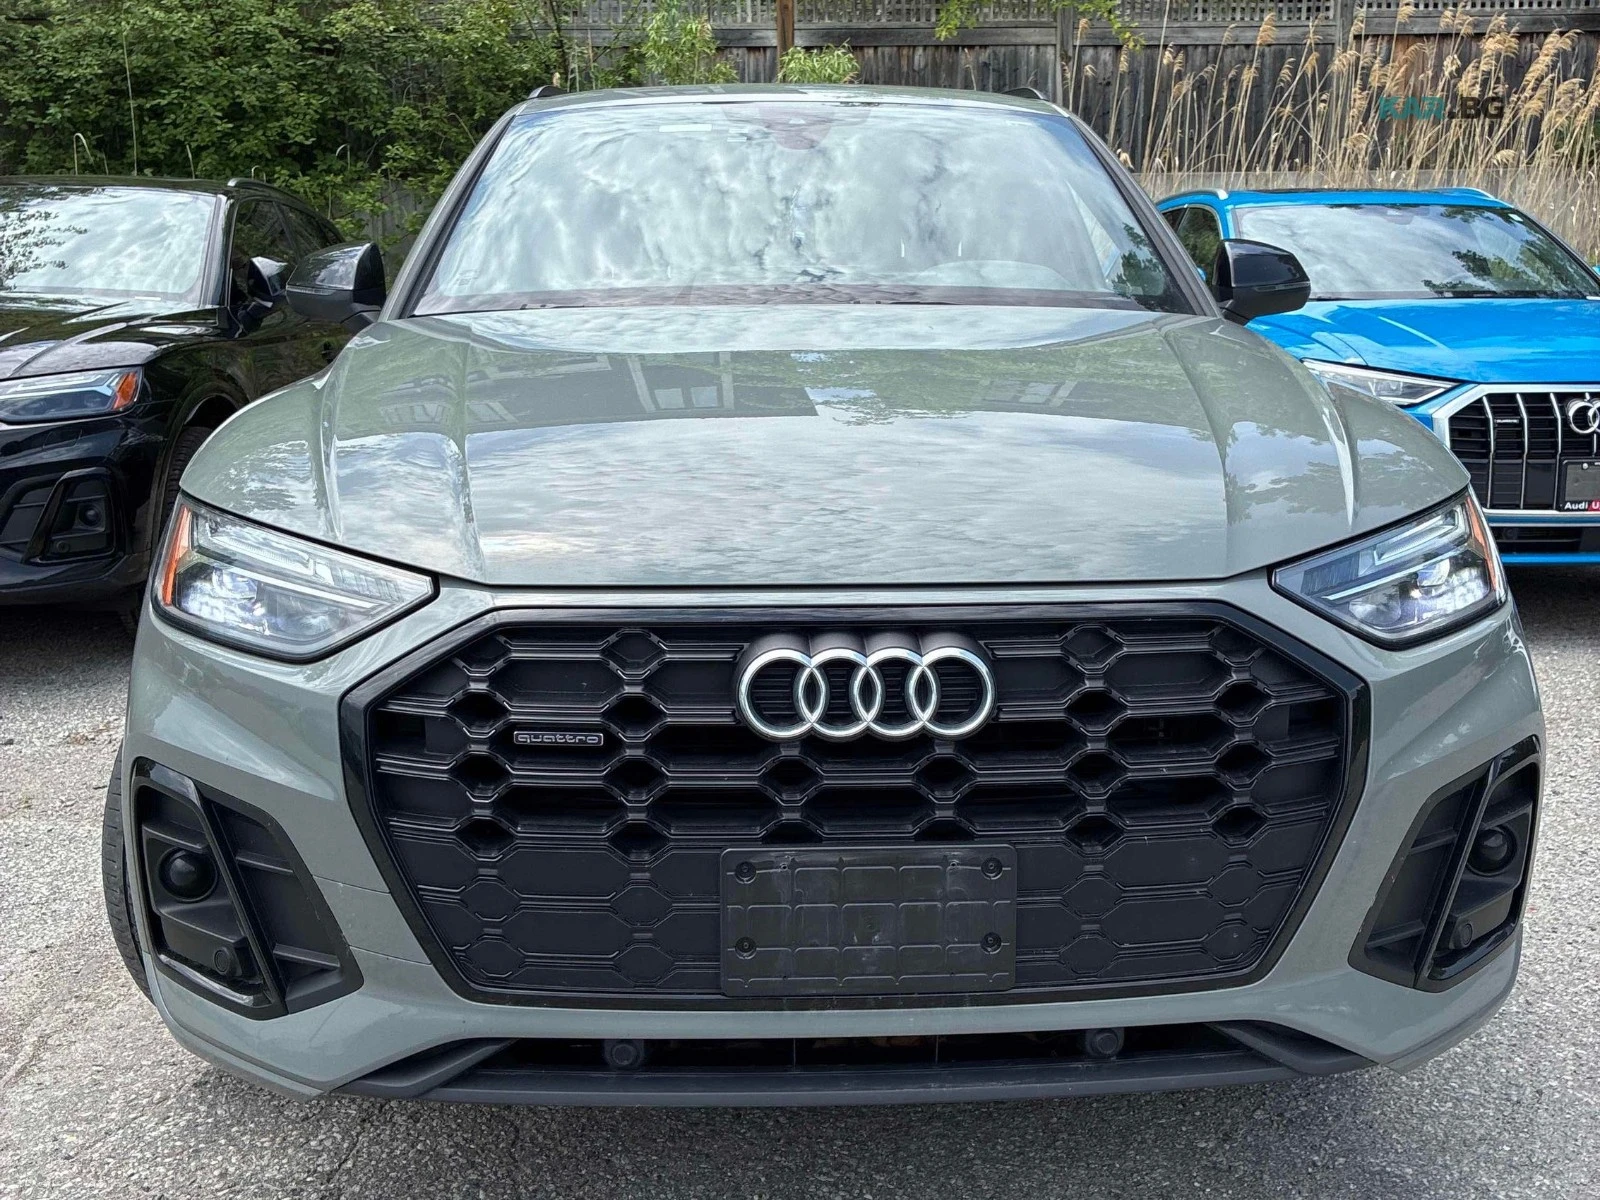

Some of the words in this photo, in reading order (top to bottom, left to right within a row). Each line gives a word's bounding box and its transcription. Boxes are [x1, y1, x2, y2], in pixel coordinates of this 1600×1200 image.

[1564, 501, 1588, 510] Audi
[1591, 501, 1600, 510] U
[517, 734, 599, 743] quattro
